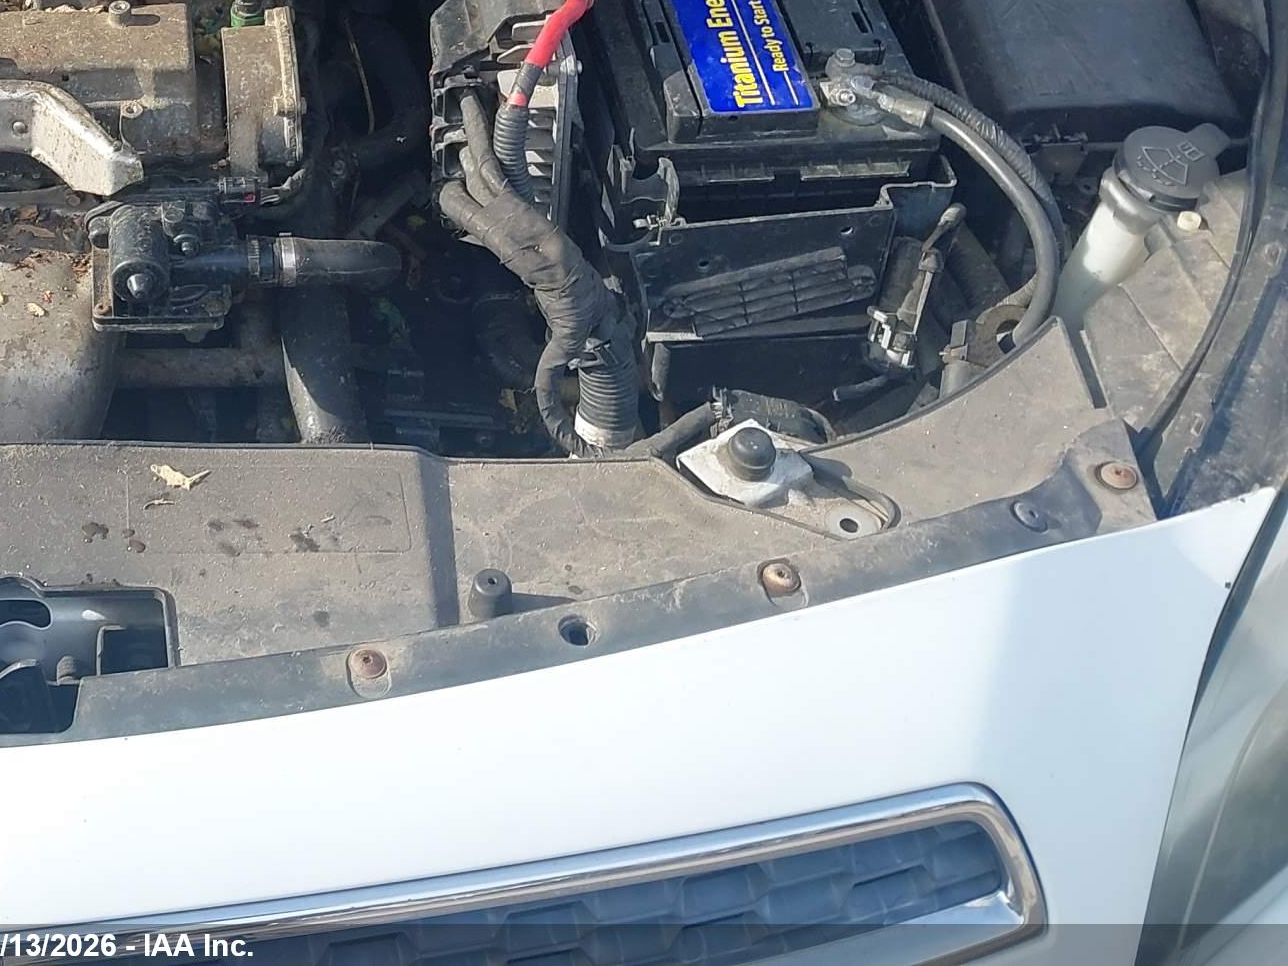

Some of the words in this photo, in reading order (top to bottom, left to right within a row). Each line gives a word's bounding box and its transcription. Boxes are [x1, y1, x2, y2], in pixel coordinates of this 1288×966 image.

[747, 0, 770, 26] Start
[760, 25, 775, 39] to
[718, 30, 763, 108] Titanium
[763, 38, 789, 72] Ready
